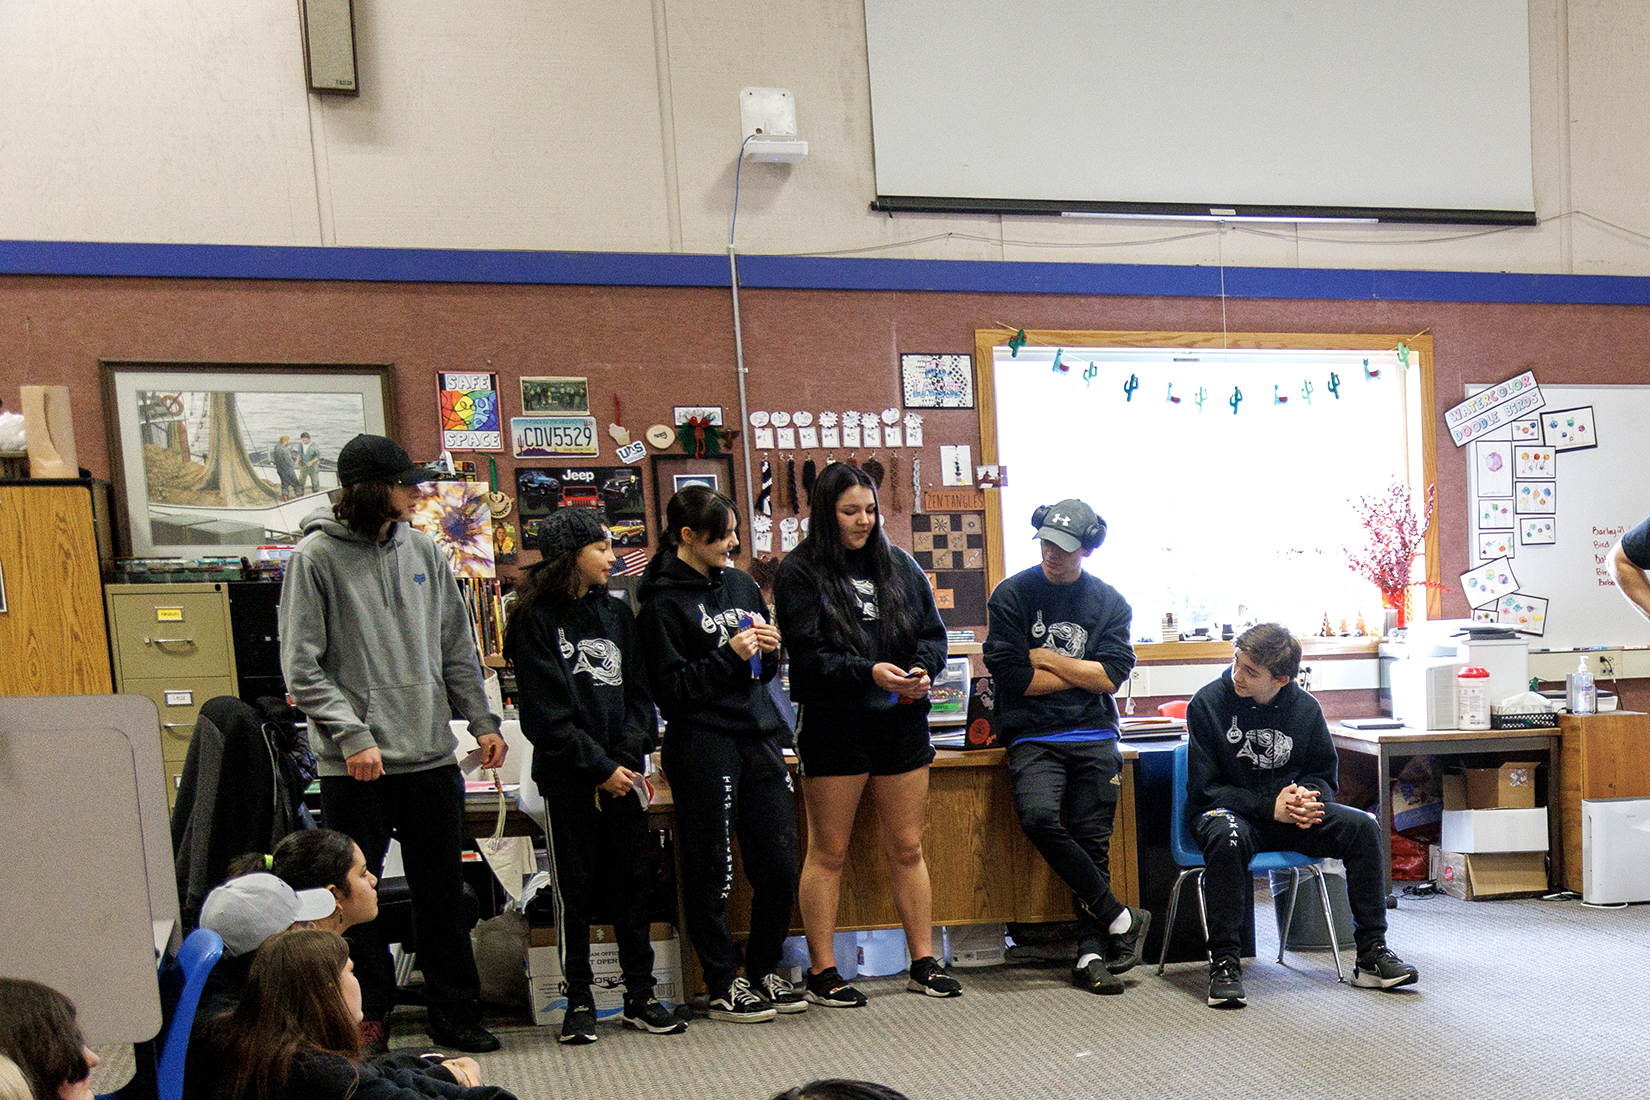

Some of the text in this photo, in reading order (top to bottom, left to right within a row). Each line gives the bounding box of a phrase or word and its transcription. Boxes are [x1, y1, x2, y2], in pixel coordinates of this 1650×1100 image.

[924, 361, 952, 379] MS.
[447, 375, 489, 390] SAFE
[1450, 375, 1532, 422] WATERCOLOR
[1453, 411, 1500, 442] DOODLE
[445, 432, 500, 448] SPACE
[524, 427, 592, 447] CDV5529
[618, 442, 644, 459] UAS
[562, 469, 595, 483] Jeep
